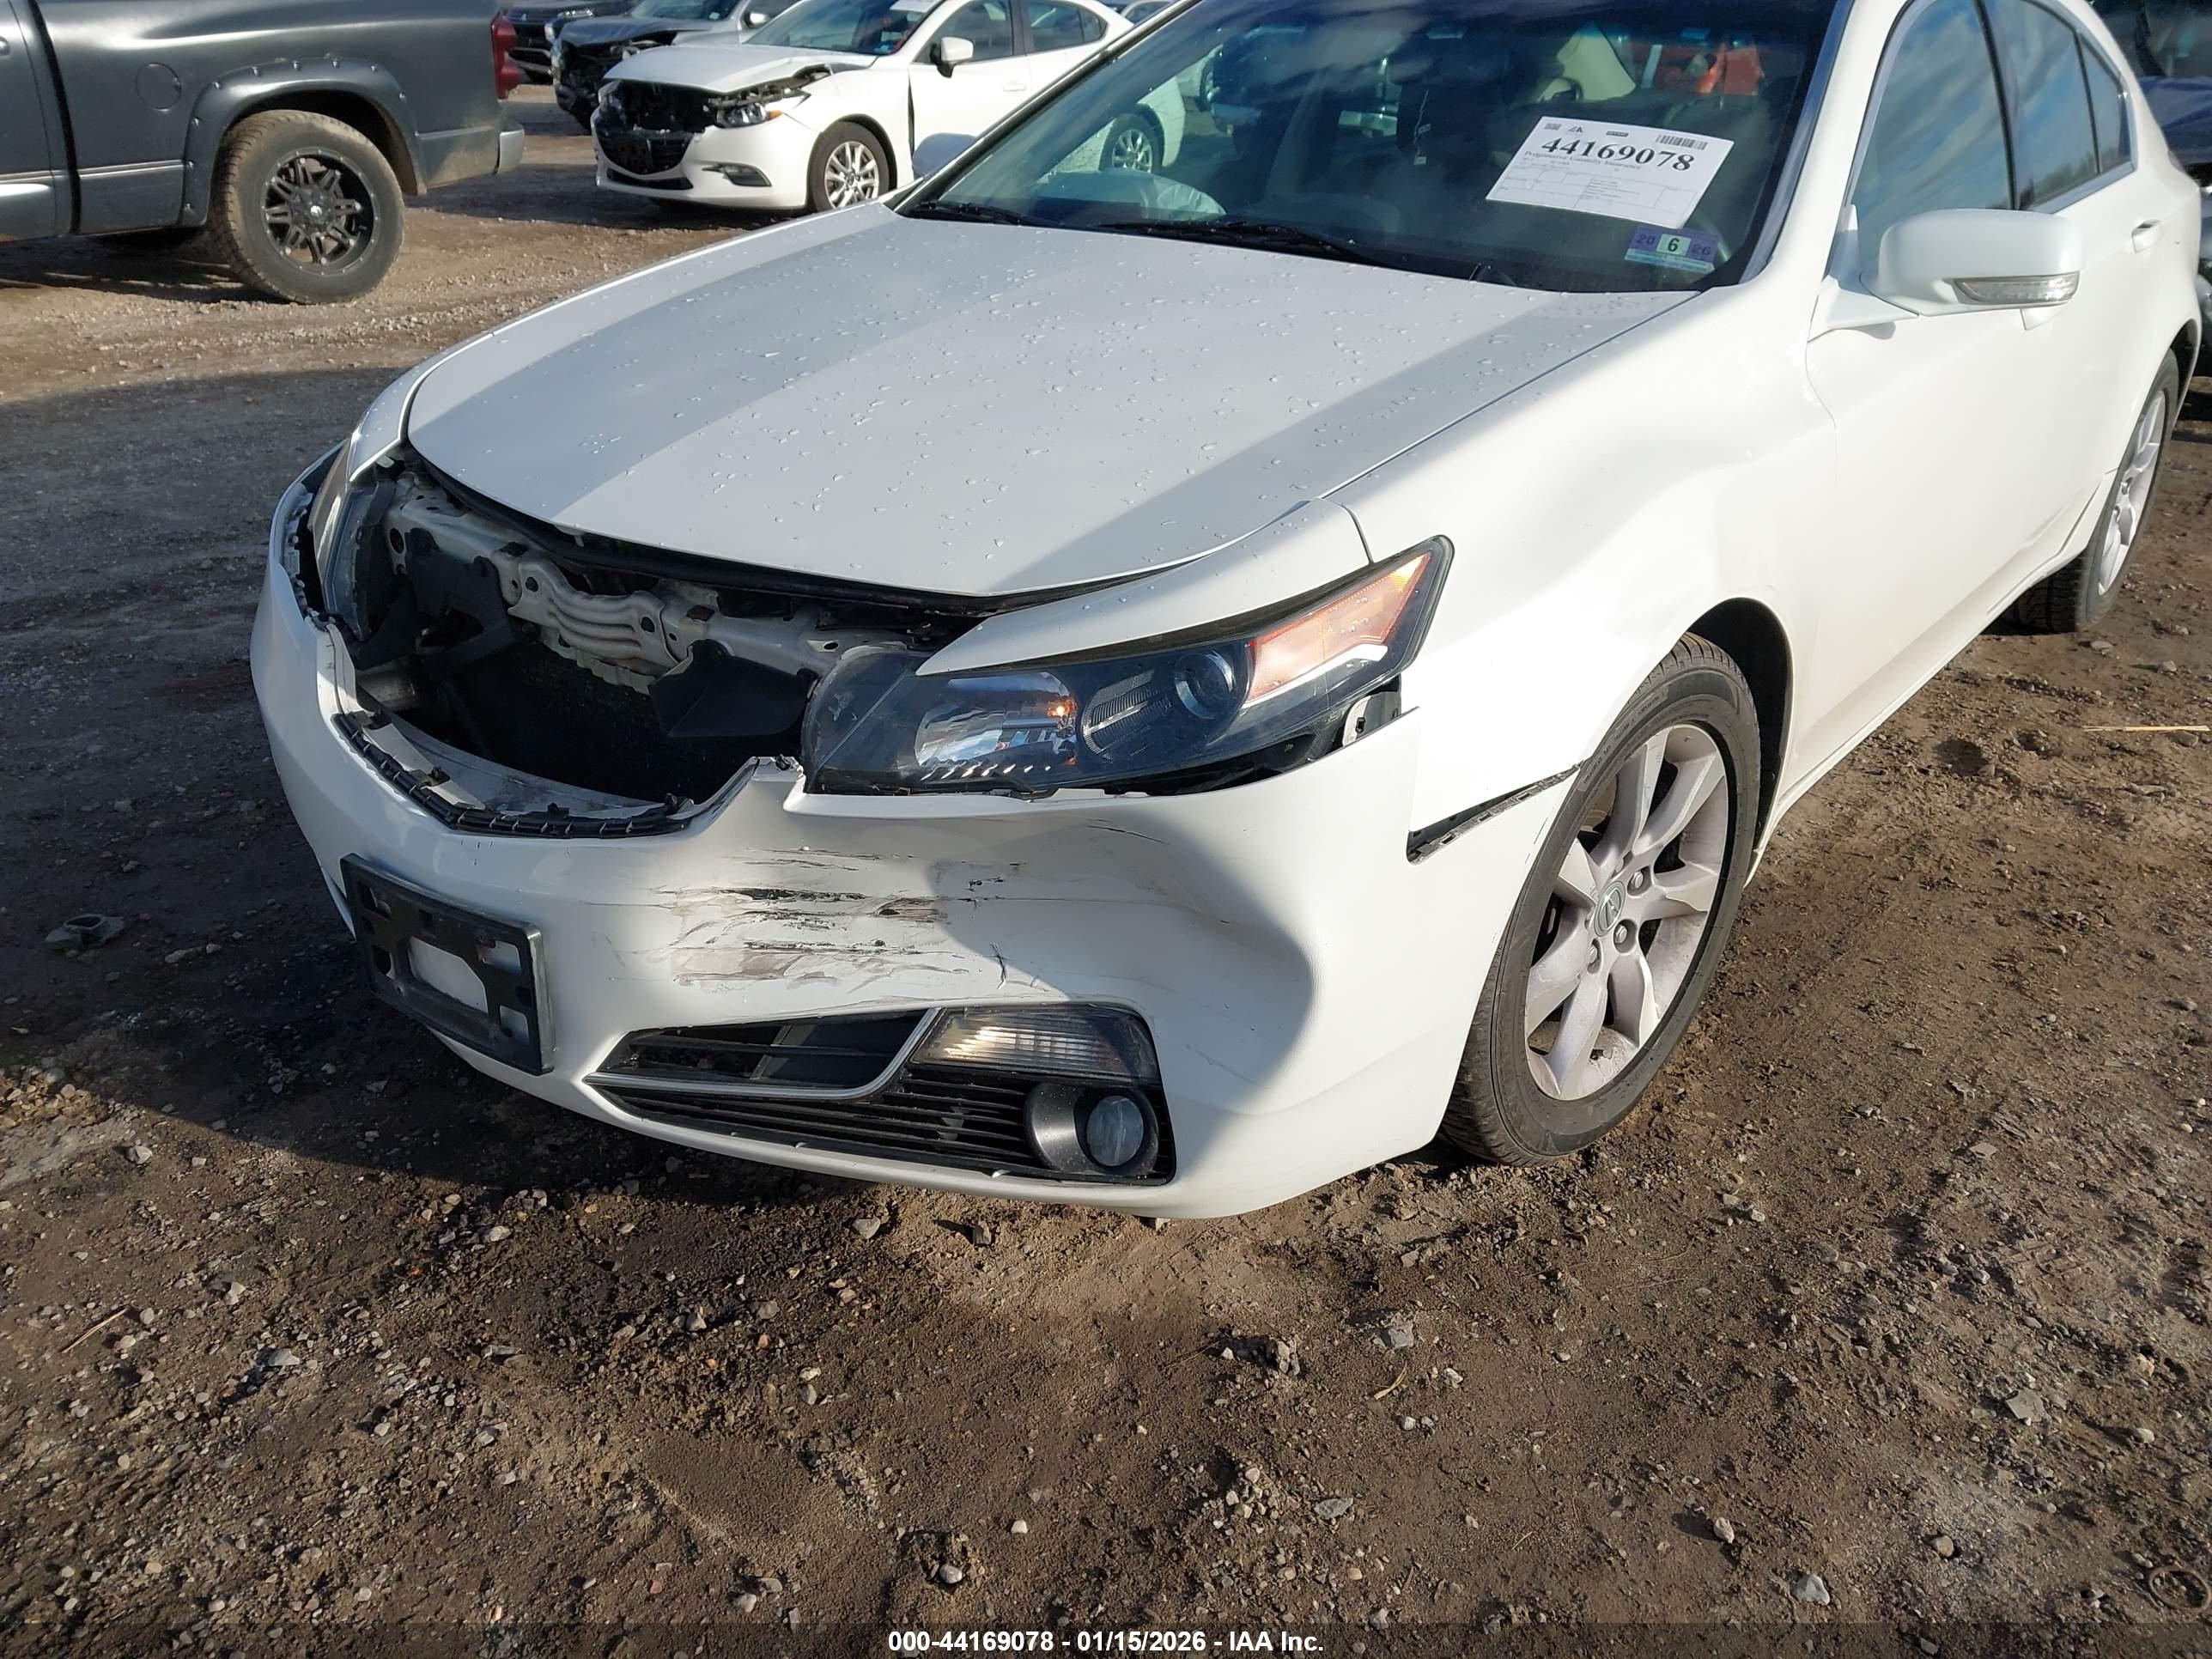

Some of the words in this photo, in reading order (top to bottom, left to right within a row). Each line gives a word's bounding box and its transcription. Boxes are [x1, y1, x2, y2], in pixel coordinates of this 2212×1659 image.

[1541, 137, 1695, 171] 44169078
[1637, 234, 1656, 245] 20
[1668, 237, 1680, 252] 6
